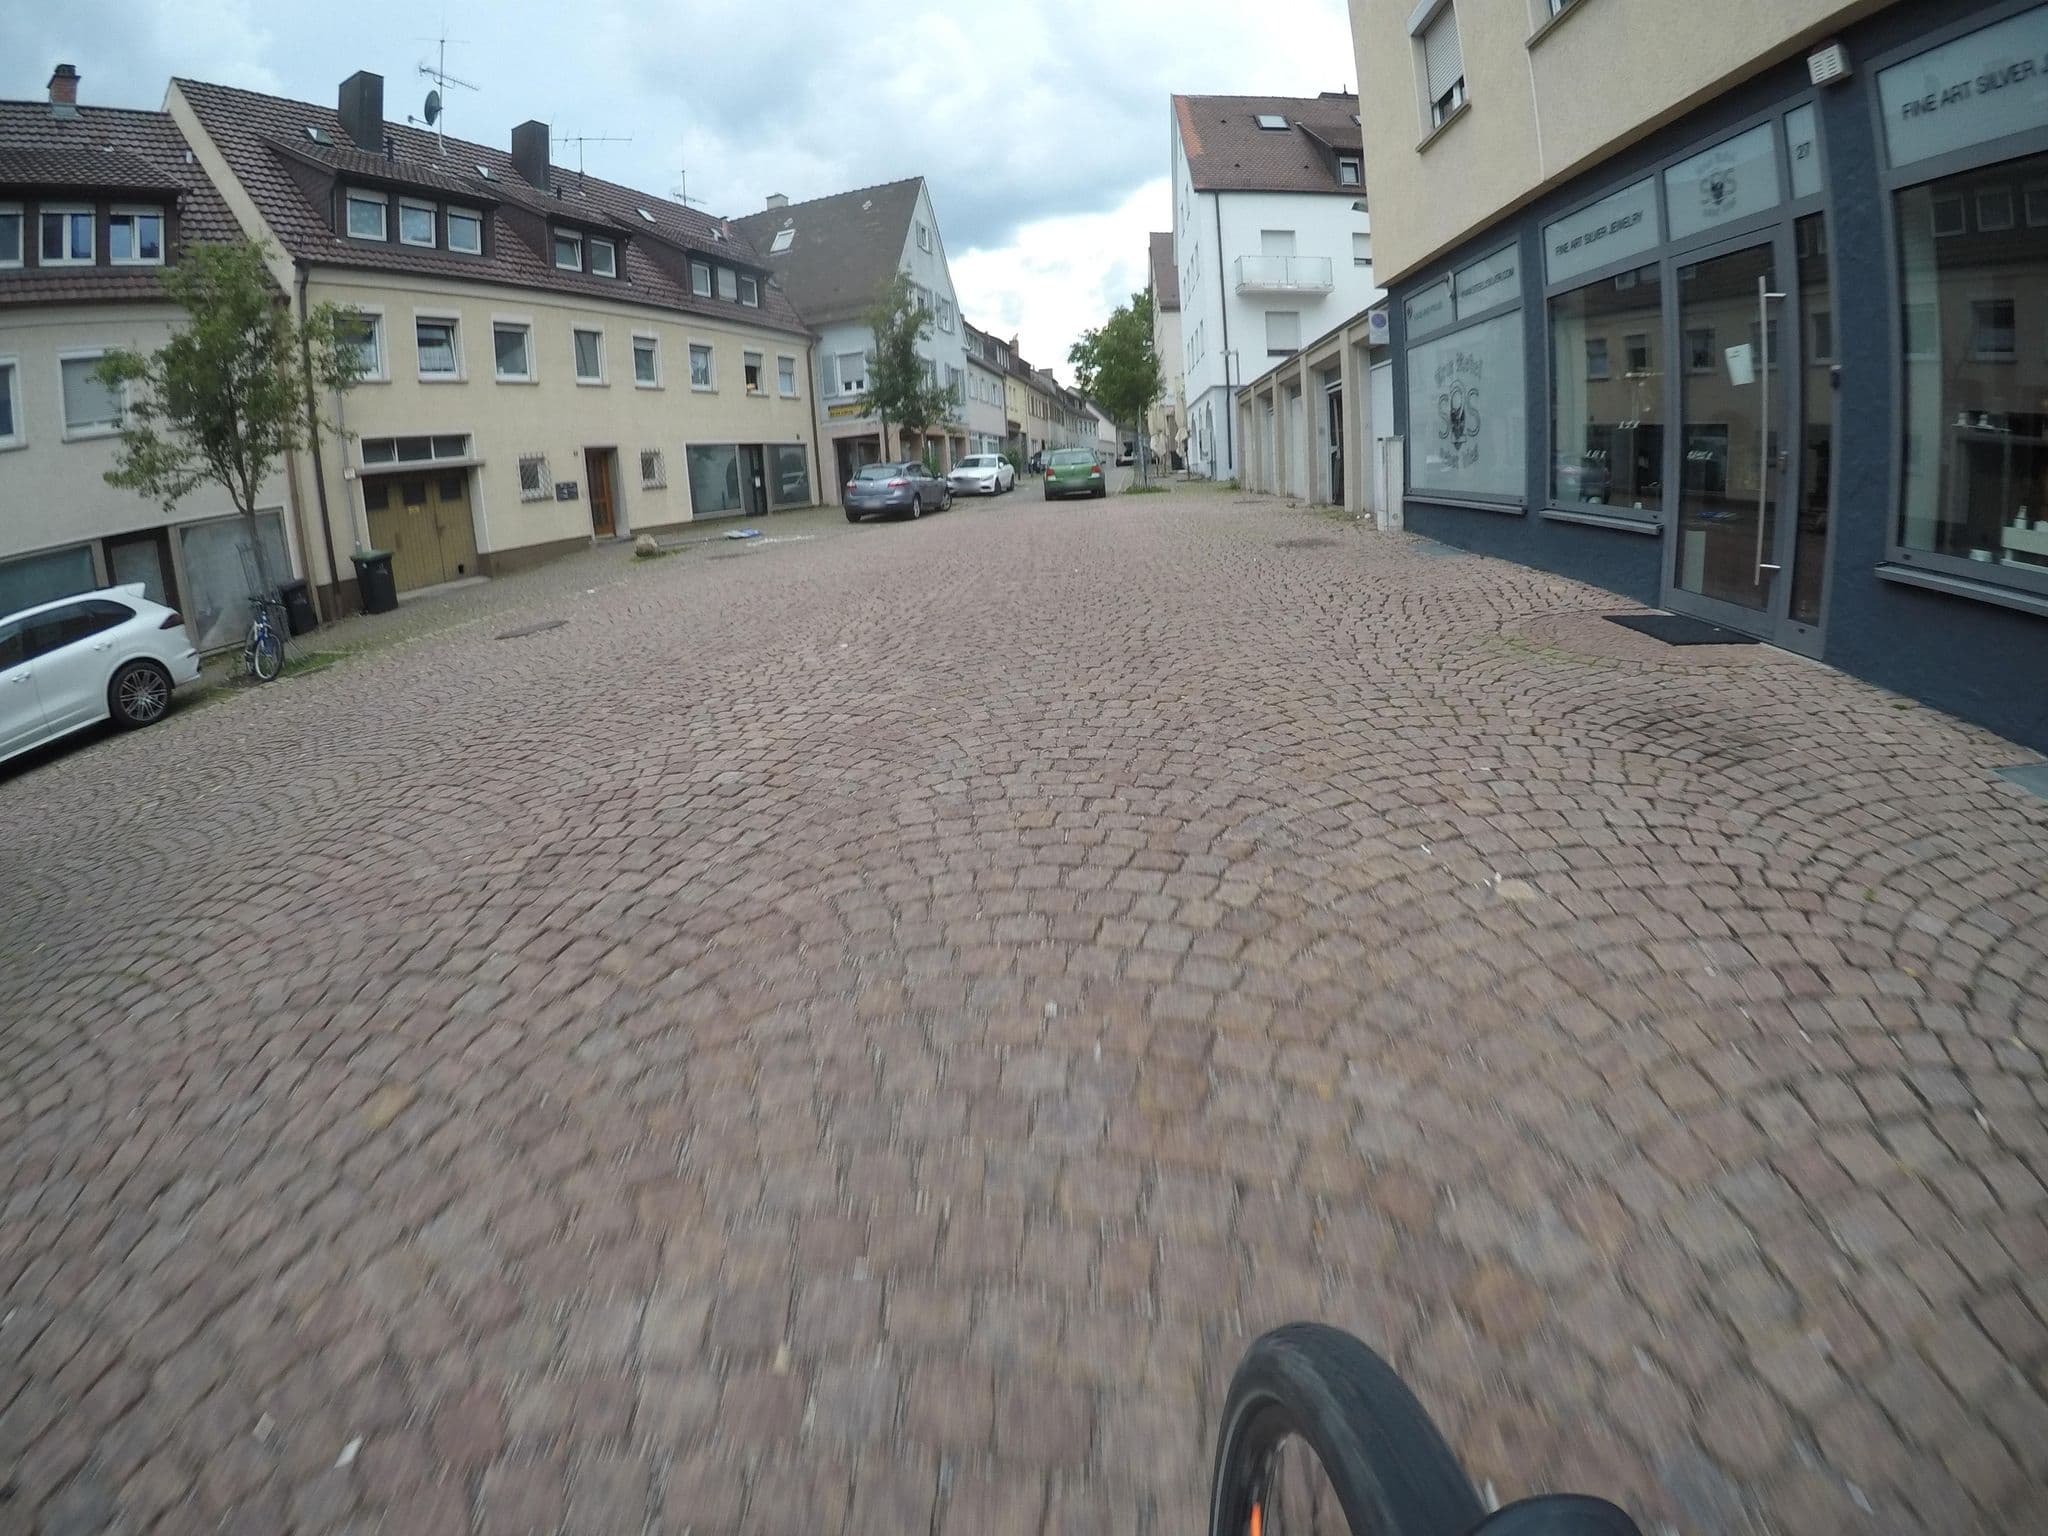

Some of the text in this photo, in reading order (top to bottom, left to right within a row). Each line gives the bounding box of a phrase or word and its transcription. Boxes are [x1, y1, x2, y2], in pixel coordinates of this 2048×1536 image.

[1902, 93, 1938, 120] FINE
[1941, 79, 1973, 107] ART
[1976, 58, 2037, 95] SILVER
[1555, 209, 1644, 257] FINE ART SILVER JEWELRY
